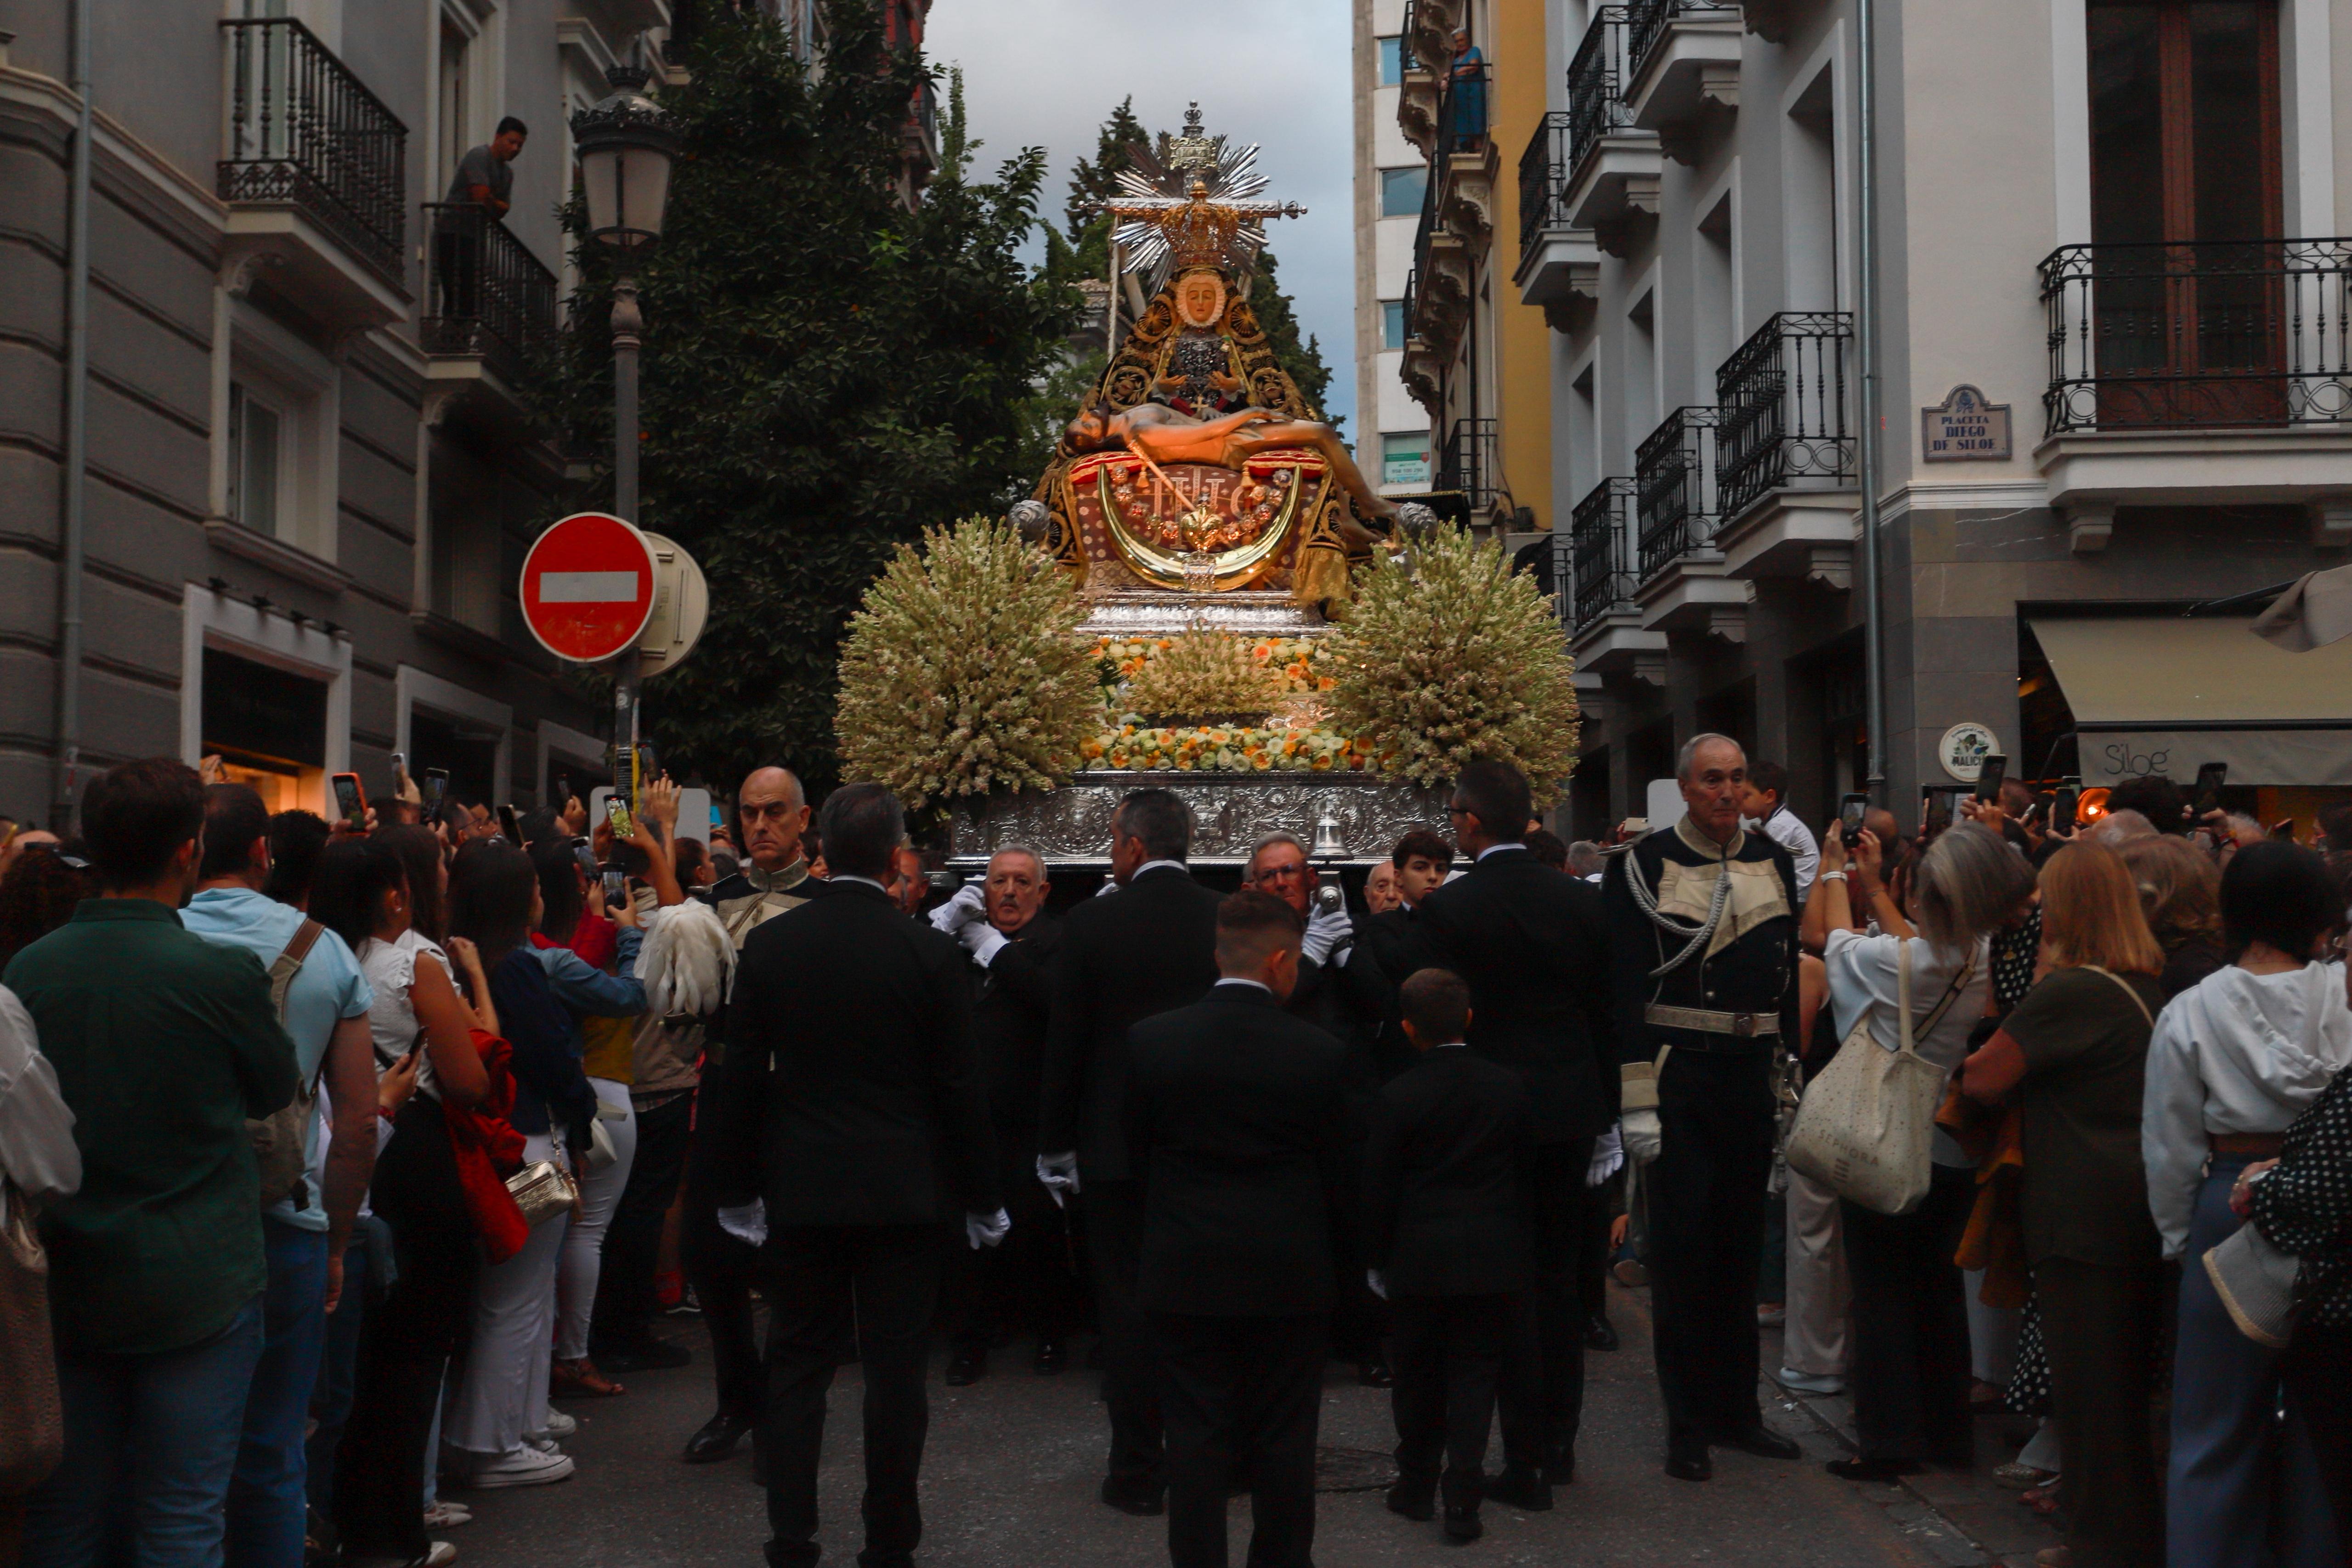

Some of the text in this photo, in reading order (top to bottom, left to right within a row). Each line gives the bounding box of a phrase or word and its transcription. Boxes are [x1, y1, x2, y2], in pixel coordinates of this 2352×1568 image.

[1941, 416, 1989, 424] PLACETA
[1945, 426, 1985, 437] DIEGO
[1933, 438, 1996, 451] DE SILOE
